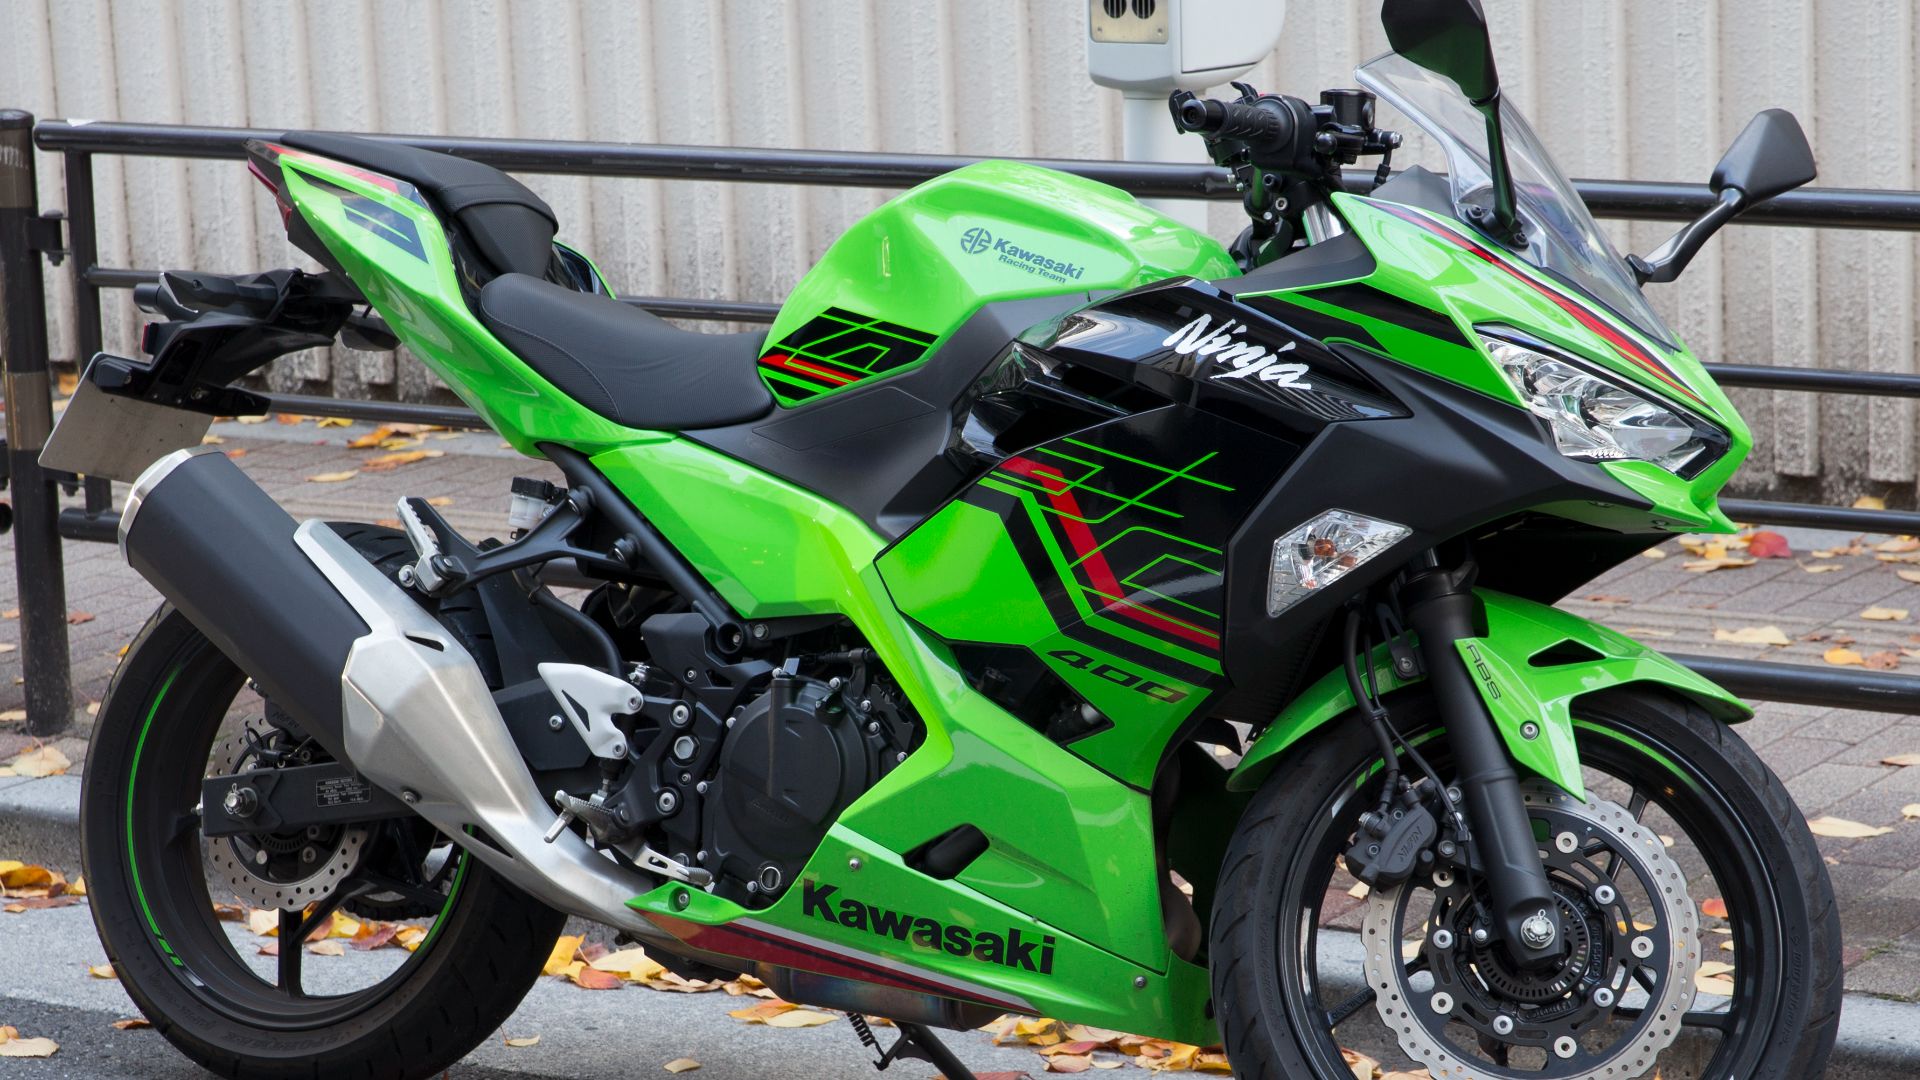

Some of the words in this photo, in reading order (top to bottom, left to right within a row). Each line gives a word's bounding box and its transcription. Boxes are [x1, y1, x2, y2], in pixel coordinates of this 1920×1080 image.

[993, 238, 1085, 280] Kawasaki
[998, 254, 1036, 274] Racing
[1038, 268, 1067, 284] Team
[1162, 313, 1312, 390] Ninja
[1046, 650, 1190, 704] 400
[1466, 644, 1502, 700] ABS
[803, 878, 1056, 975] Kawasaki
